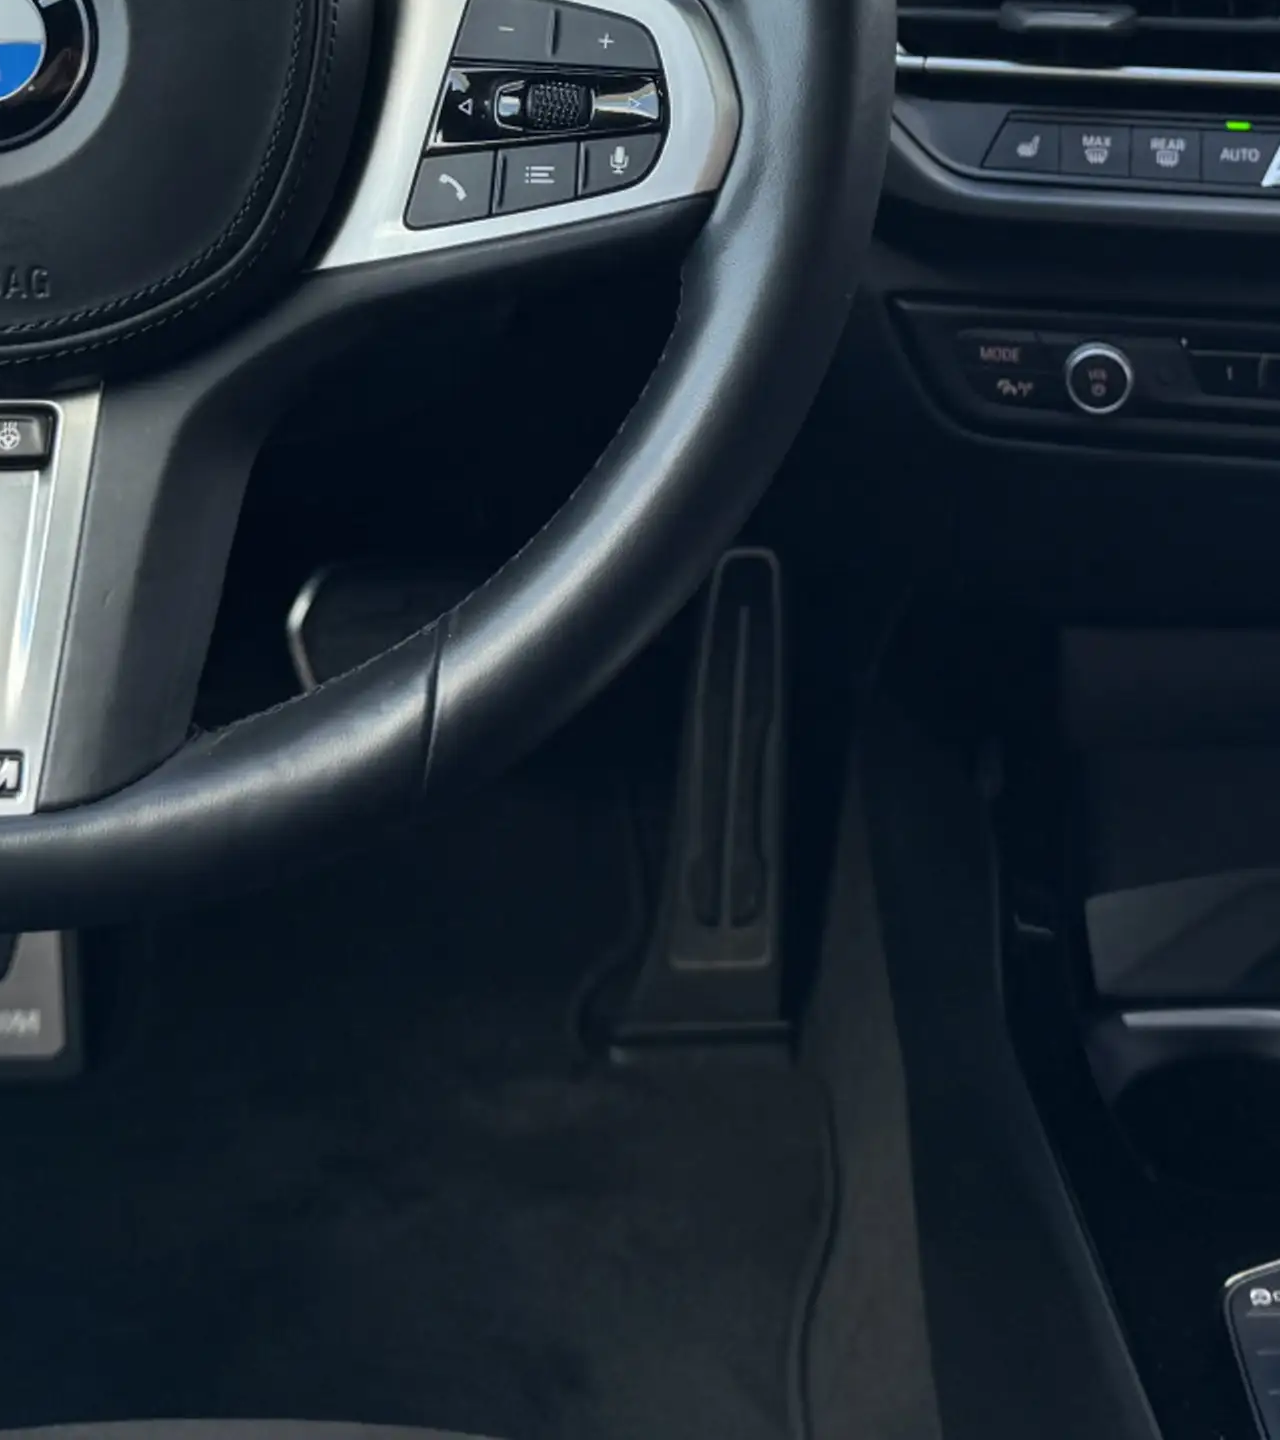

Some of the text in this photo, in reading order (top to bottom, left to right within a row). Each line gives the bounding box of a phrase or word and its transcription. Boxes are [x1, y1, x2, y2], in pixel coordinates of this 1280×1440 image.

[1081, 135, 1112, 149] MAX
[1150, 137, 1186, 152] REAR
[1219, 147, 1261, 163] AUTO
